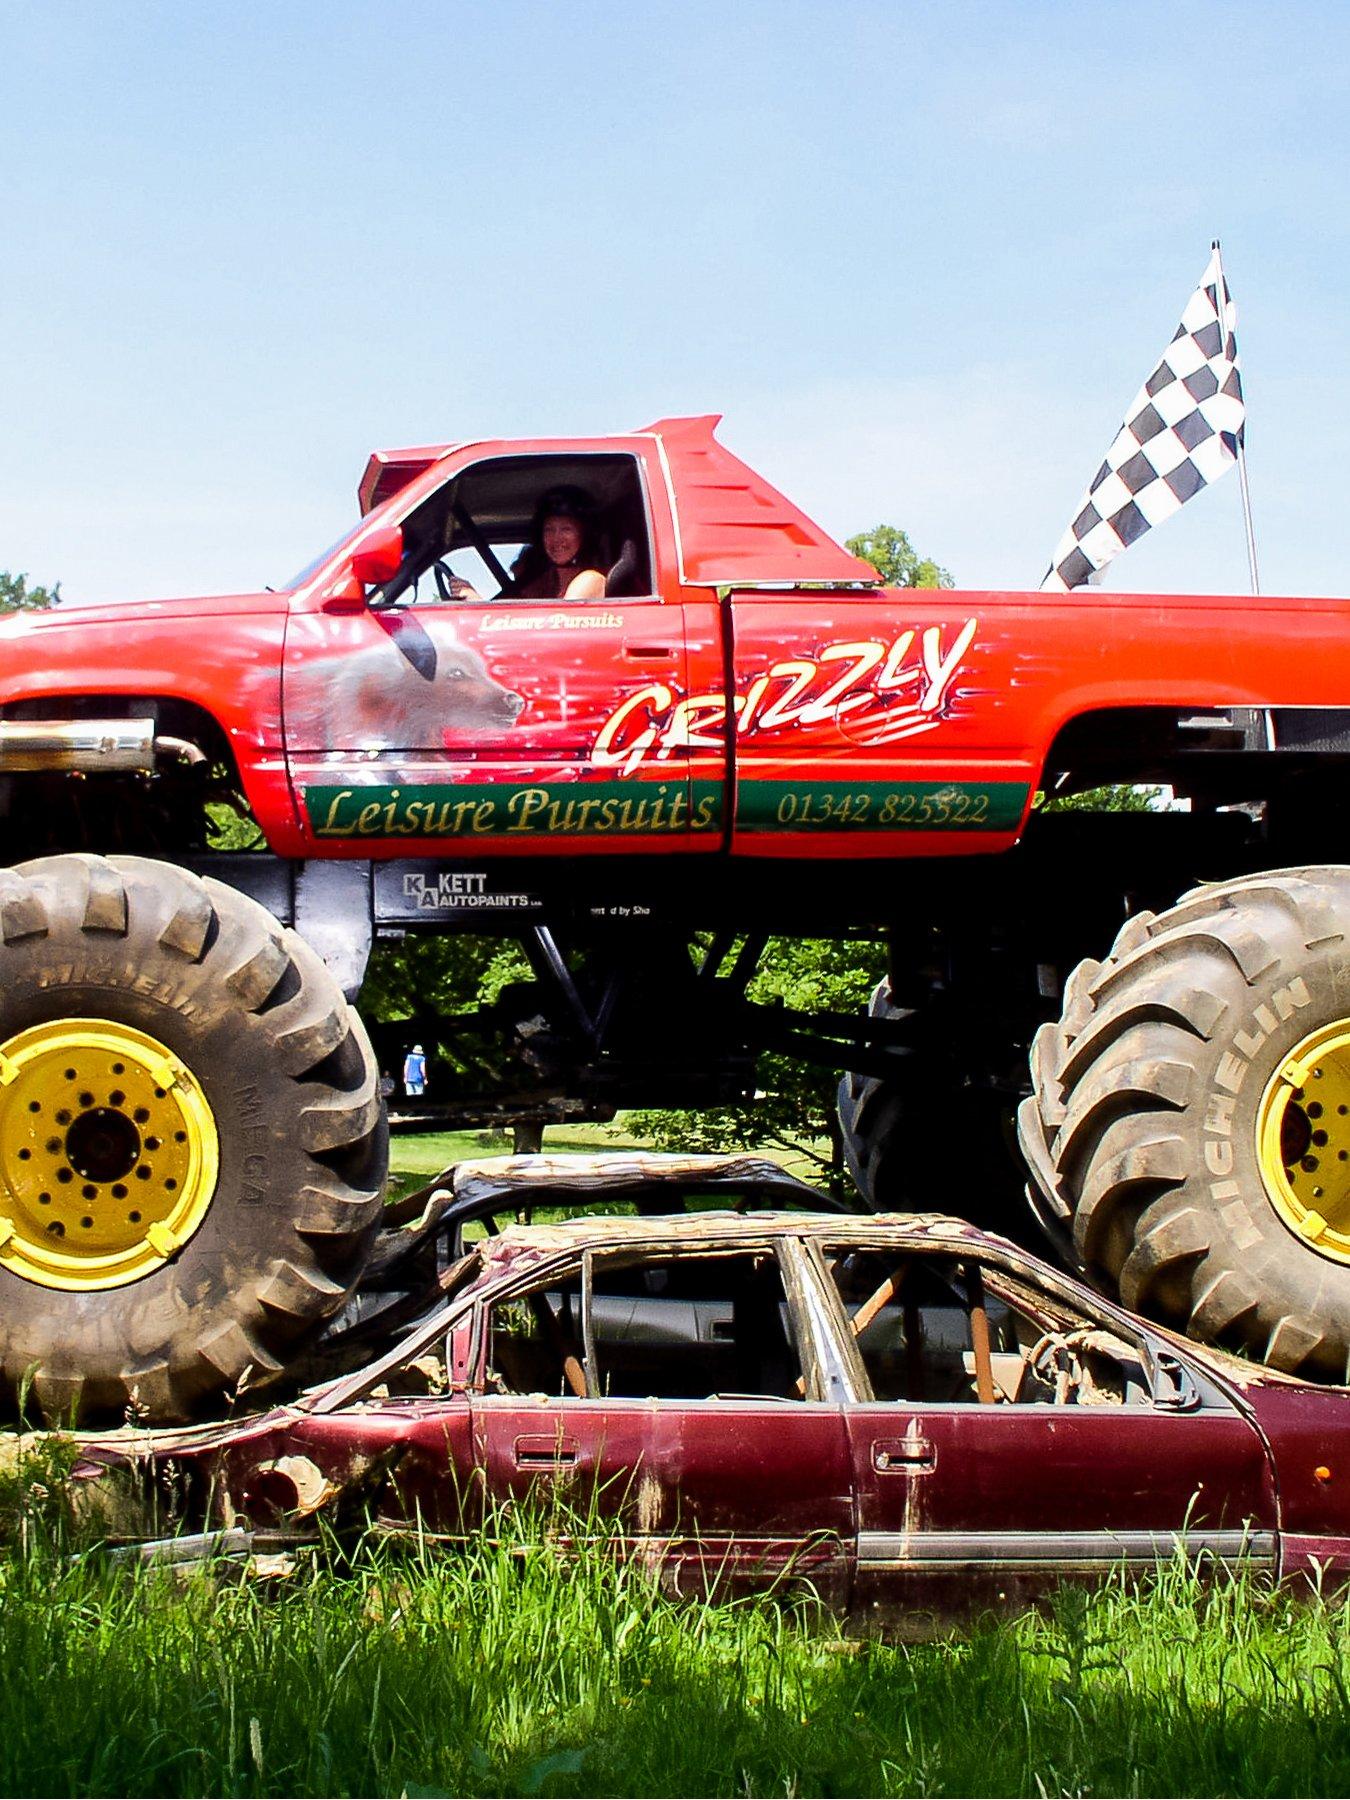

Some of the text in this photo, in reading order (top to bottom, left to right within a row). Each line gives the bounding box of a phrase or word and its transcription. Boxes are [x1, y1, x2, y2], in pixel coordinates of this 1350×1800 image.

[479, 612, 624, 632] Leisure Pursuits
[592, 618, 977, 776] GRIZZLY
[317, 785, 715, 834] Leisure Pursuits
[777, 793, 871, 823] 01342
[439, 873, 487, 893] KETT
[439, 895, 528, 907] AUTOPAINTS
[1203, 976, 1311, 1250] MICHELIN
